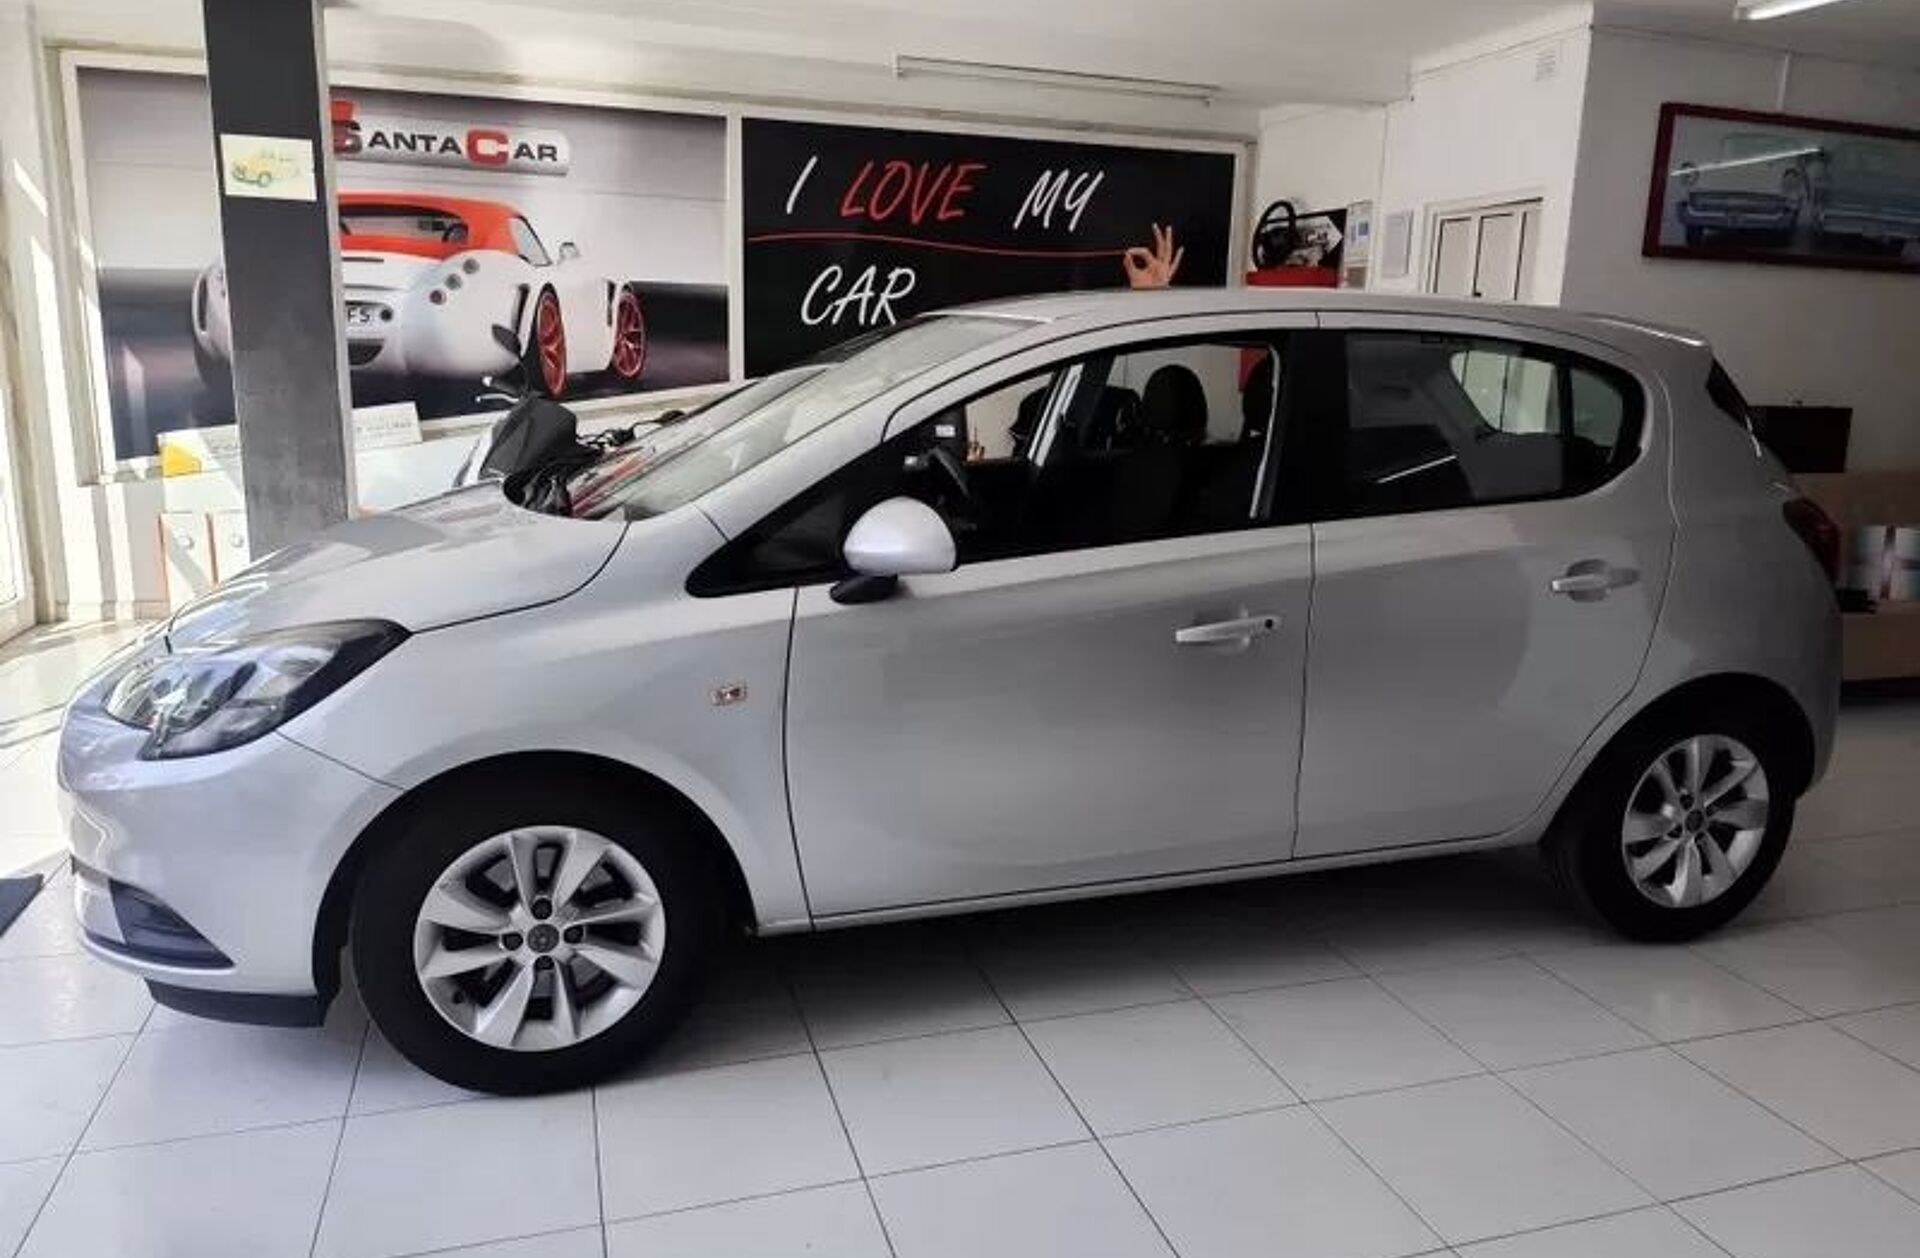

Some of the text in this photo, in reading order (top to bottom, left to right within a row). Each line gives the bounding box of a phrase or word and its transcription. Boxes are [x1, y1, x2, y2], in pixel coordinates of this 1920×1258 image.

[786, 155, 1105, 232] I LOVE MY
[800, 264, 916, 326] CAR
